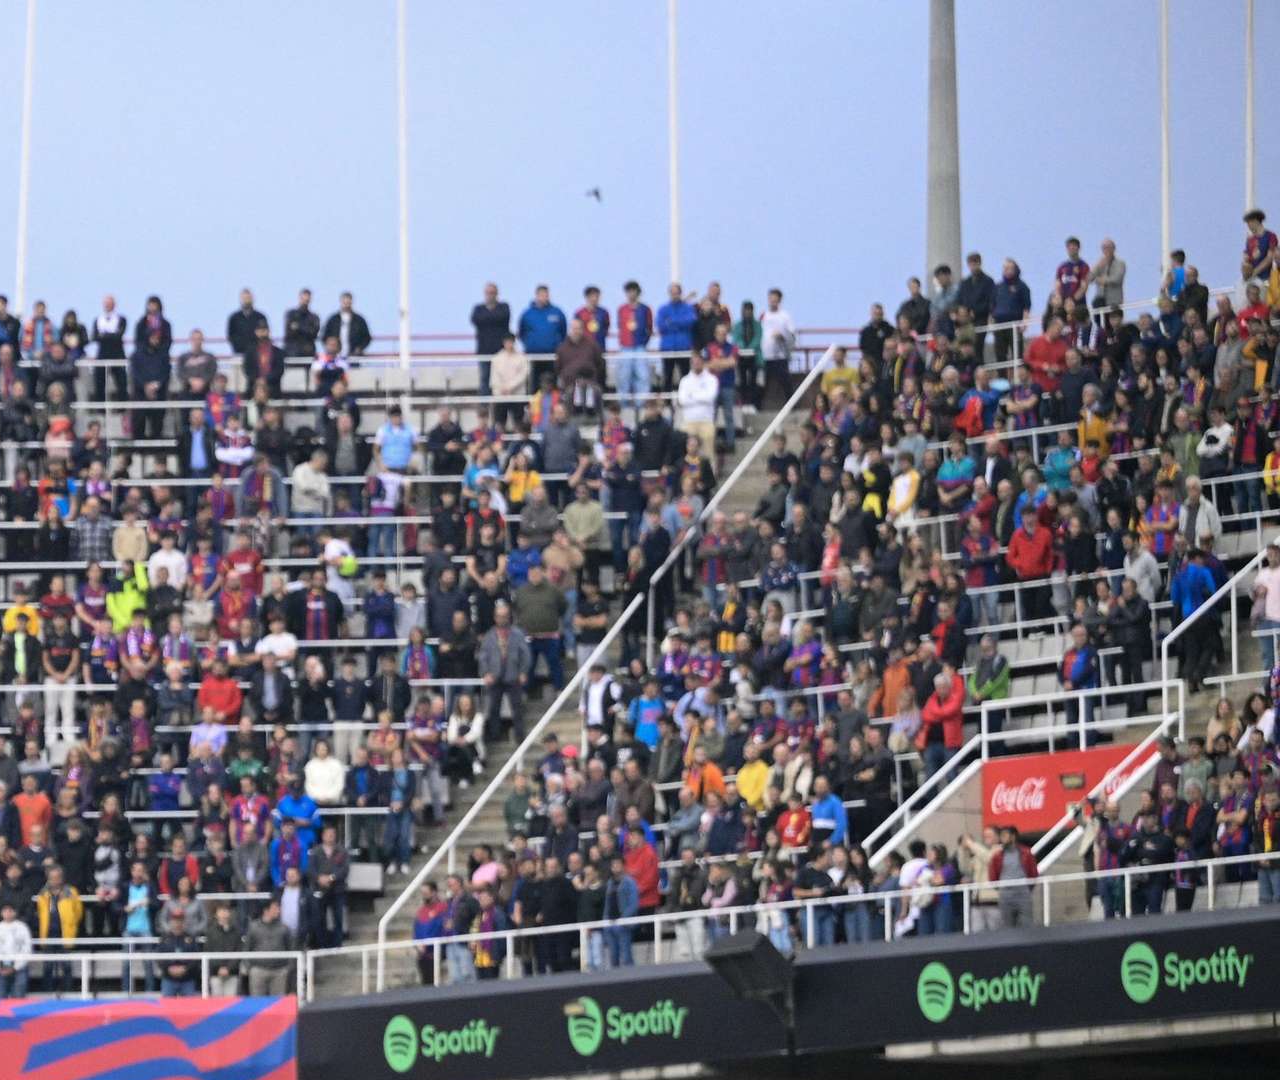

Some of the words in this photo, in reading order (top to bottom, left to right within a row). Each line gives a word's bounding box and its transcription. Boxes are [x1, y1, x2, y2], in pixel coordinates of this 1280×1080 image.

[959, 965, 1044, 1010] Spotify
[1164, 946, 1249, 992] Spotify
[421, 1020, 499, 1062] Spotify
[606, 1000, 687, 1044] Spotify
